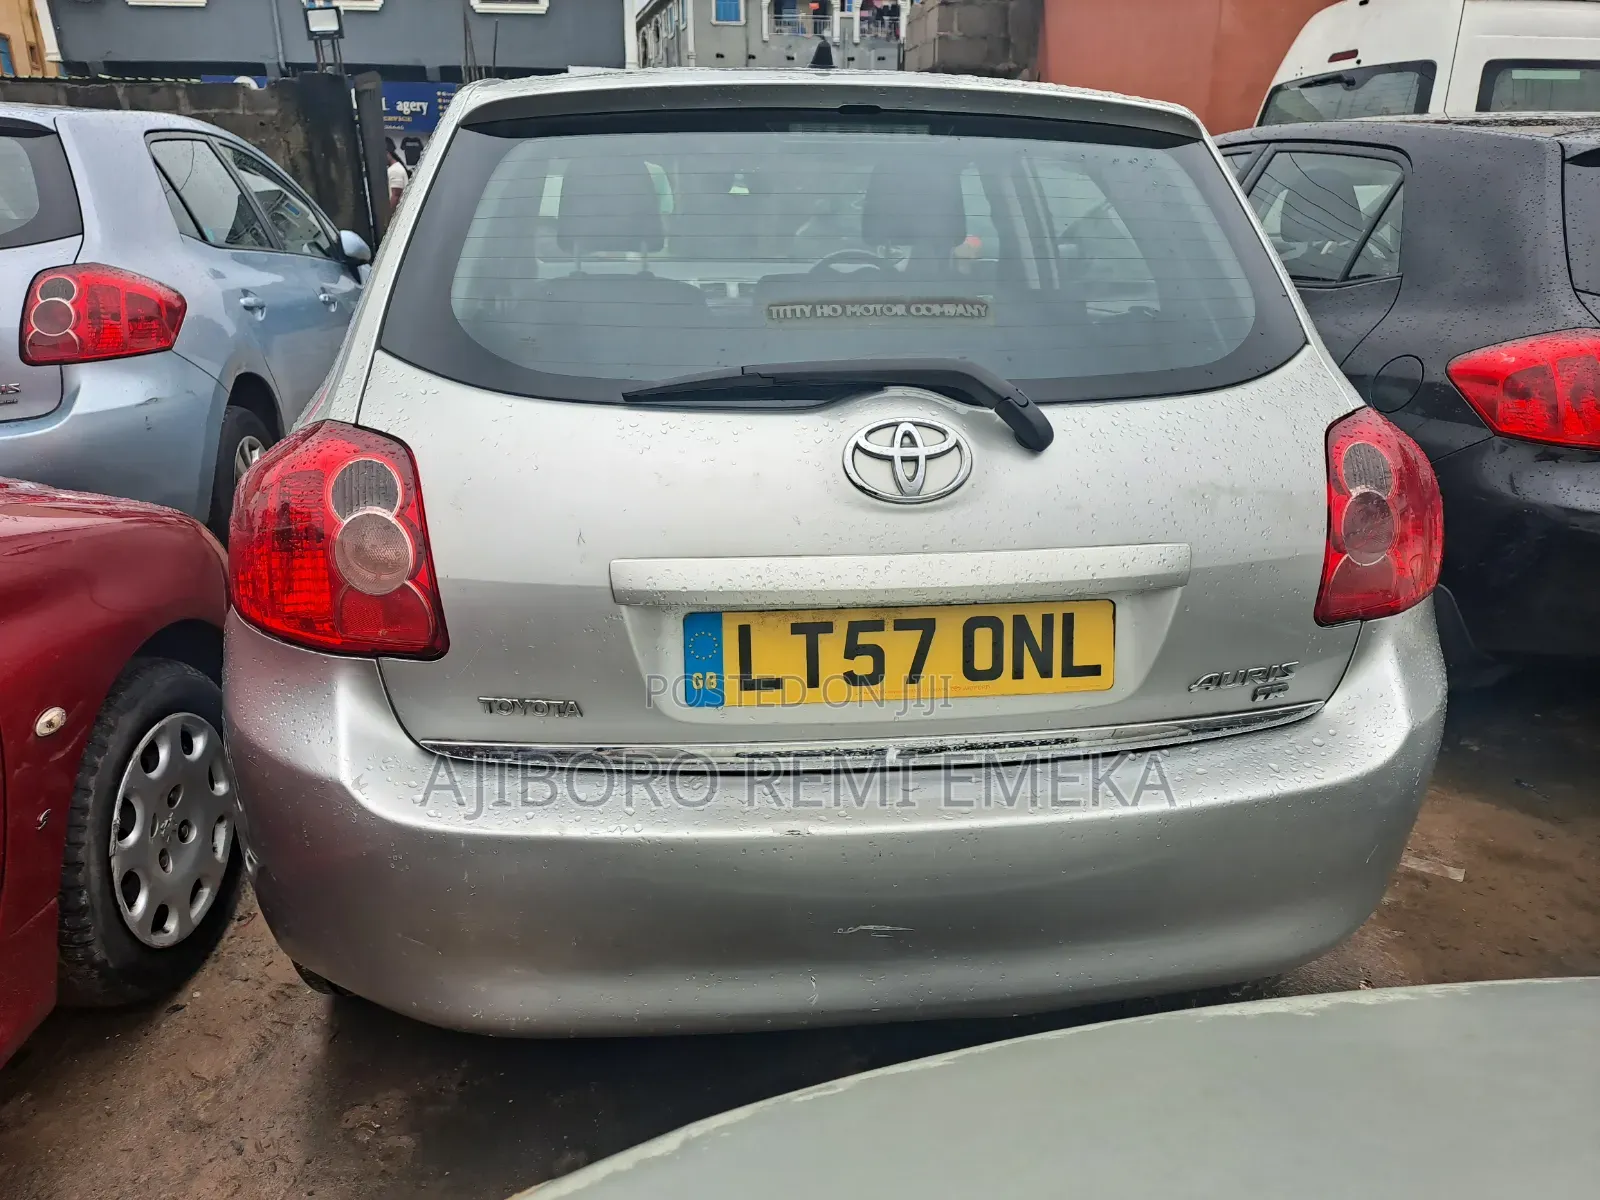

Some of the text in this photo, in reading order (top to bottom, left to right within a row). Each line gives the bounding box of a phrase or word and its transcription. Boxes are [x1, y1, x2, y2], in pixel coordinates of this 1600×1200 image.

[845, 303, 907, 317] MOTOR
[909, 303, 988, 317] COMPANY
[737, 612, 1102, 692] LT57 ONL
[692, 672, 717, 690] GB
[1188, 661, 1299, 692] AURIS
[478, 696, 583, 718] TOYOTA
